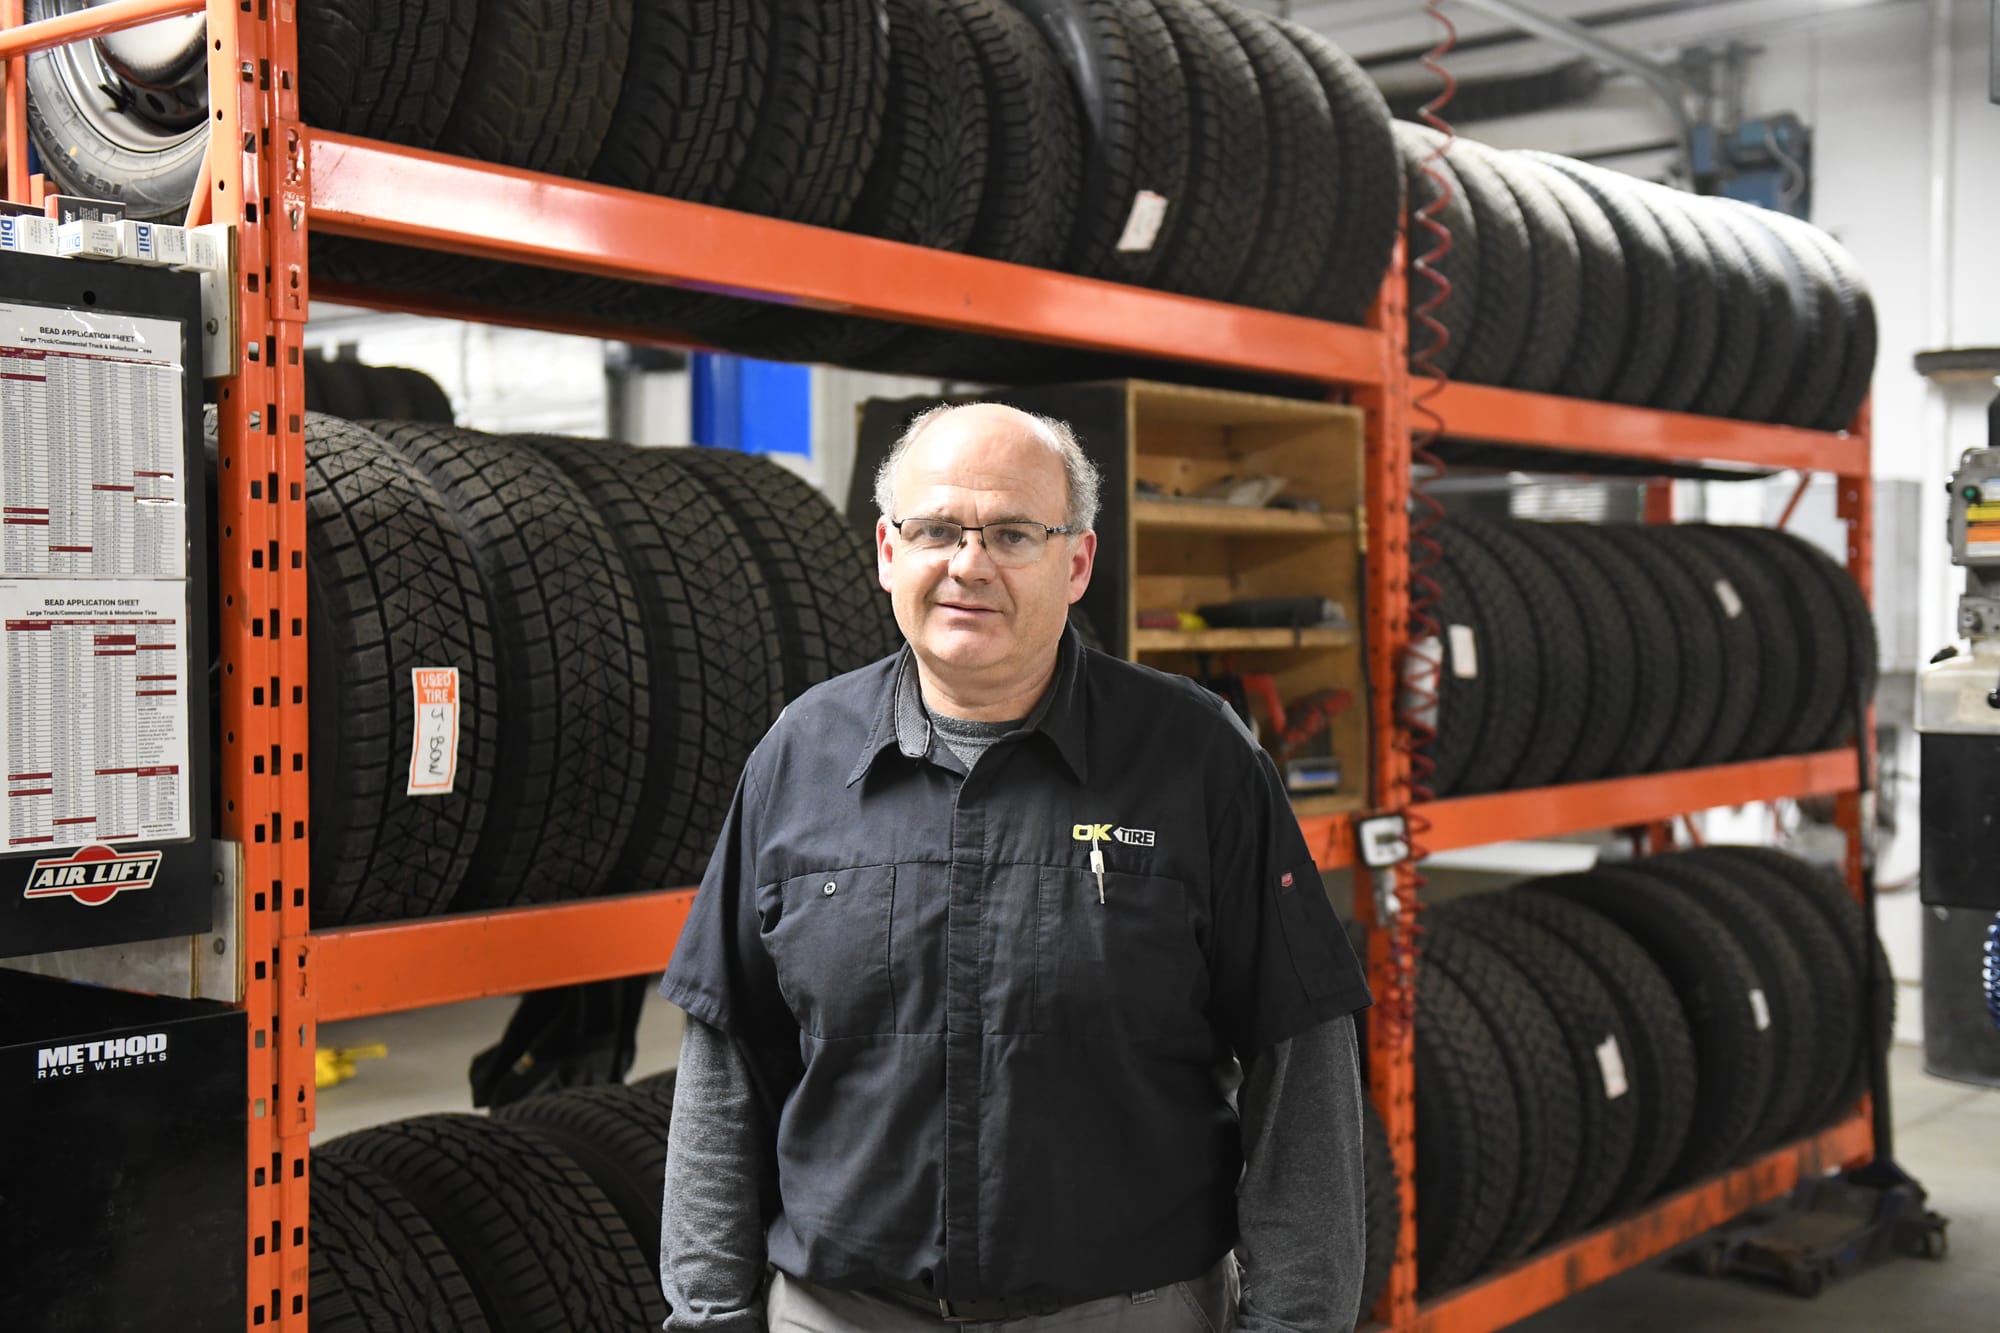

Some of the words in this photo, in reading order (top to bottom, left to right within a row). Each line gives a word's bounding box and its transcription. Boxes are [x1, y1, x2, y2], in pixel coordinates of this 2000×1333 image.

[1, 220, 13, 246] Dill
[138, 226, 150, 252] Dill
[39, 326, 60, 335] BEAD
[61, 329, 110, 339] APPLICATION
[420, 671, 452, 688] USED
[424, 689, 449, 704] TIRE
[1072, 823, 1113, 841] OK
[1119, 828, 1154, 845] TIRE
[34, 866, 87, 888] AIR
[92, 861, 153, 883] LIFT
[38, 1033, 168, 1069] METHOD
[37, 1064, 85, 1079] RACE
[95, 1052, 168, 1071] WHEELS
